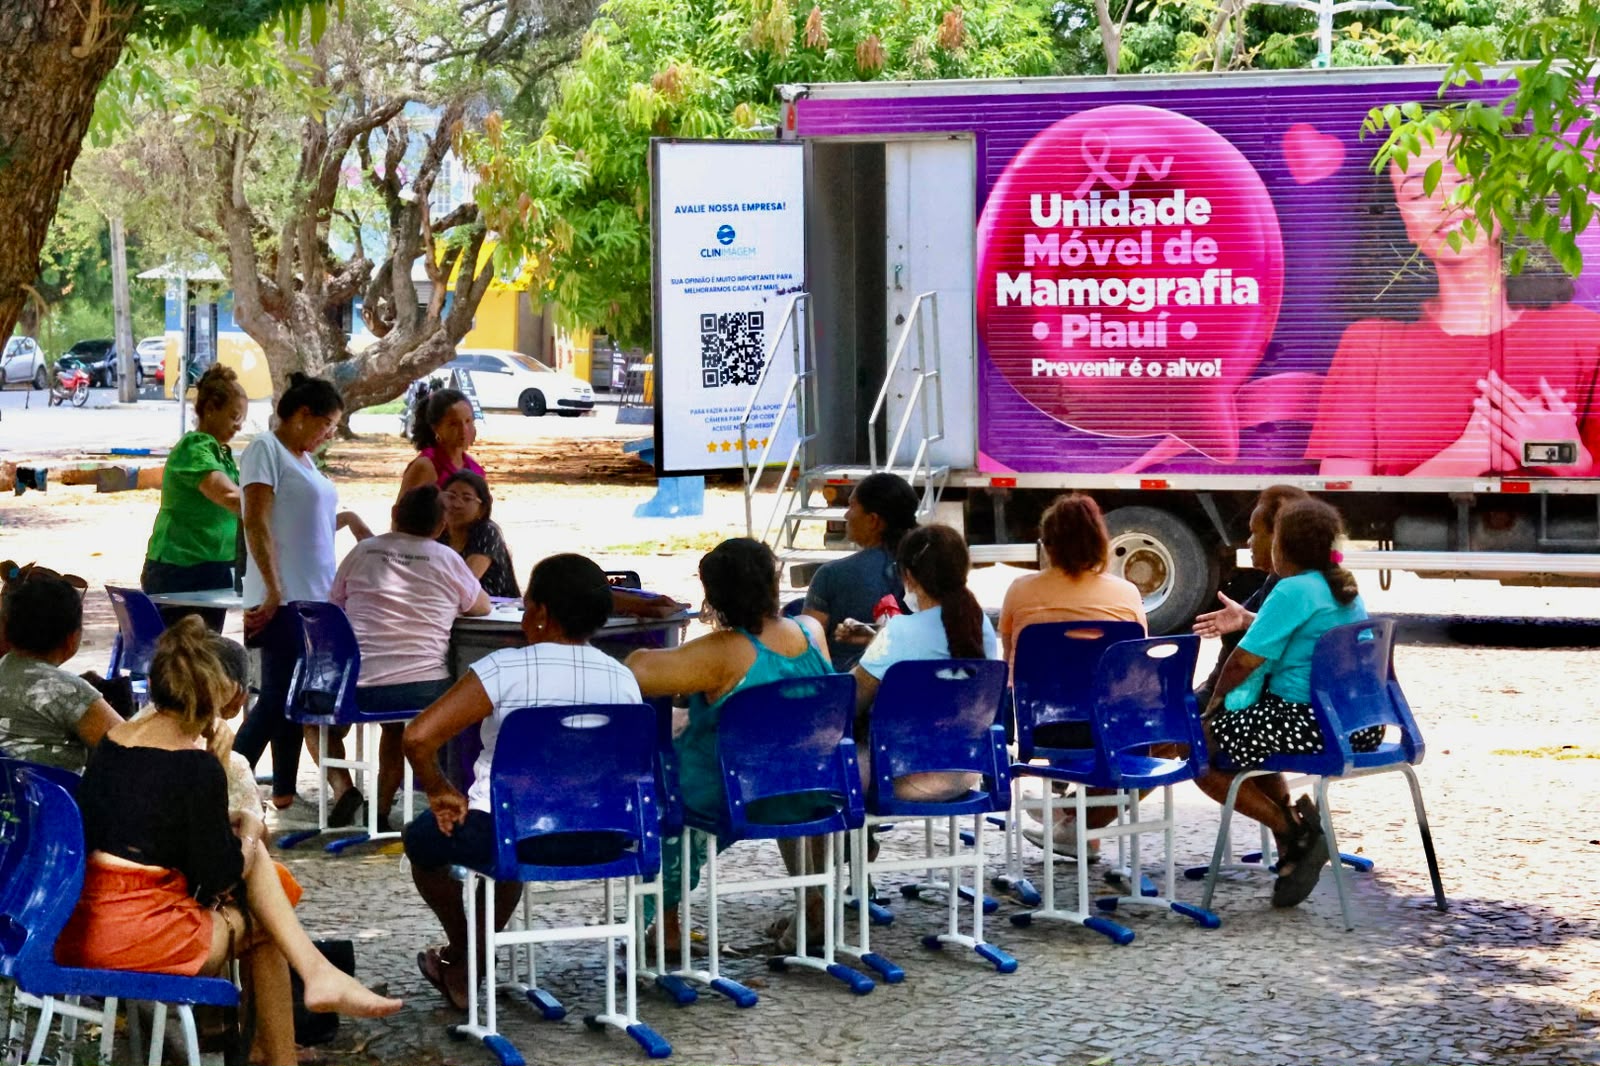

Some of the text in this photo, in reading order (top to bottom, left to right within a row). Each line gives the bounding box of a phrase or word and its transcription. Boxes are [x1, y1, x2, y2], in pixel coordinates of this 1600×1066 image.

[674, 202, 786, 214] AVALIE NOSSA EMPRESA!
[1029, 190, 1212, 228] Unidade
[700, 247, 756, 258] CLINIMAGEM
[1023, 229, 1219, 266] Móvel de
[684, 276, 711, 284] OPINIÃO
[716, 275, 736, 283] MUITO
[737, 274, 775, 282] IMPORTANTE
[684, 286, 731, 294] MELHORARMOS
[995, 268, 1260, 312] Mamografia
[1061, 312, 1171, 348] Piauí
[1031, 357, 1222, 378] Prevenir é o alvo!
